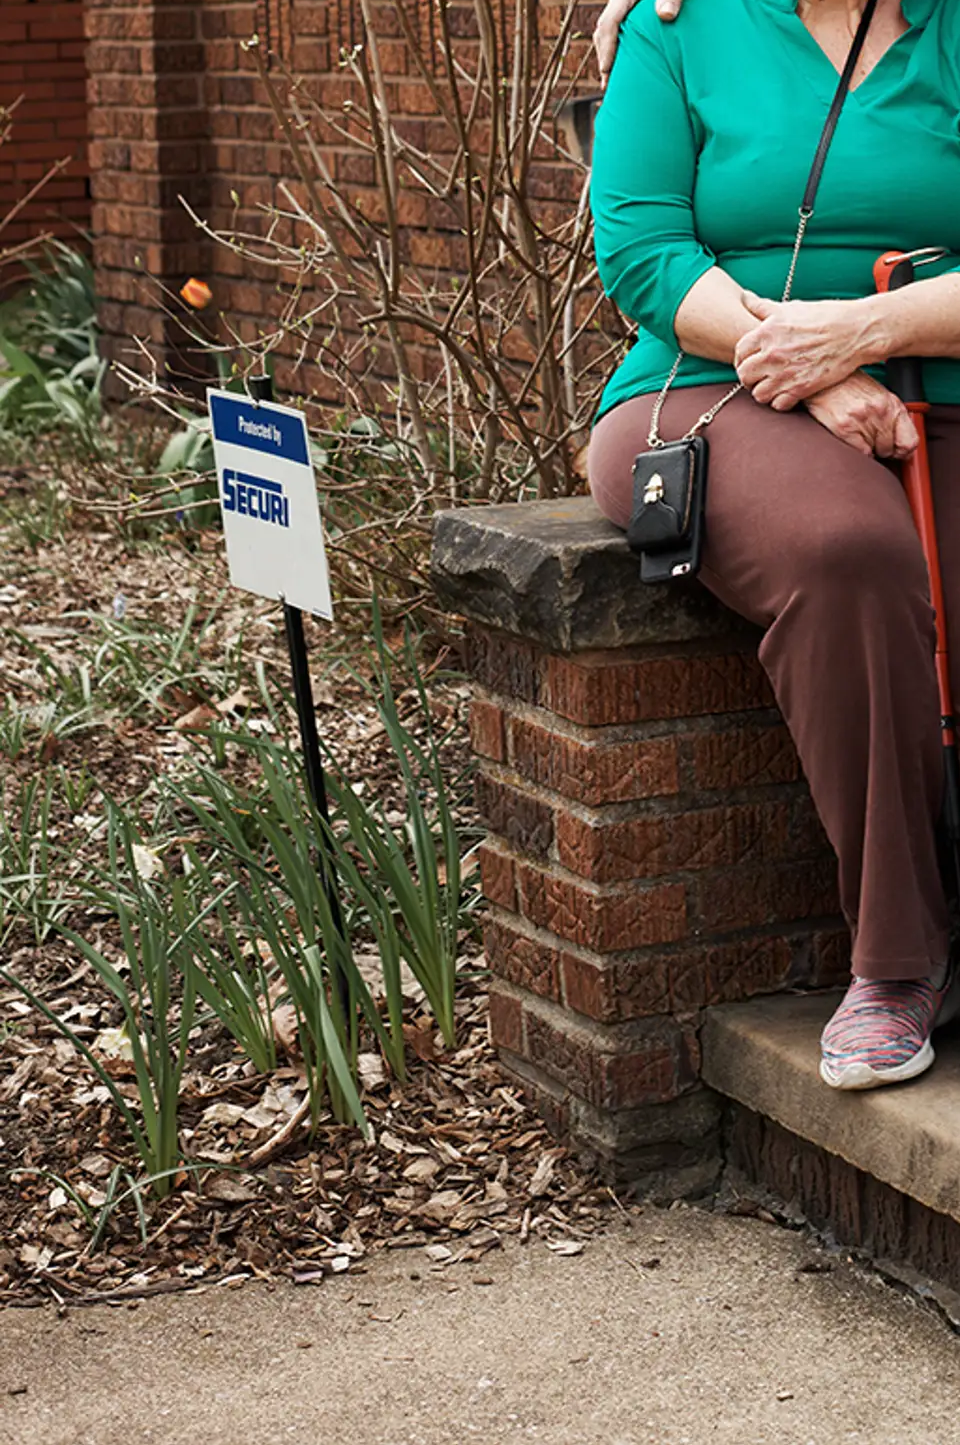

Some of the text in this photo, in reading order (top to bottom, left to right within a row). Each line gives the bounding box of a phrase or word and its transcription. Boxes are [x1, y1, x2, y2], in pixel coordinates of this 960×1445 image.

[238, 415, 282, 447] Protected by
[222, 468, 290, 528] SECURI
